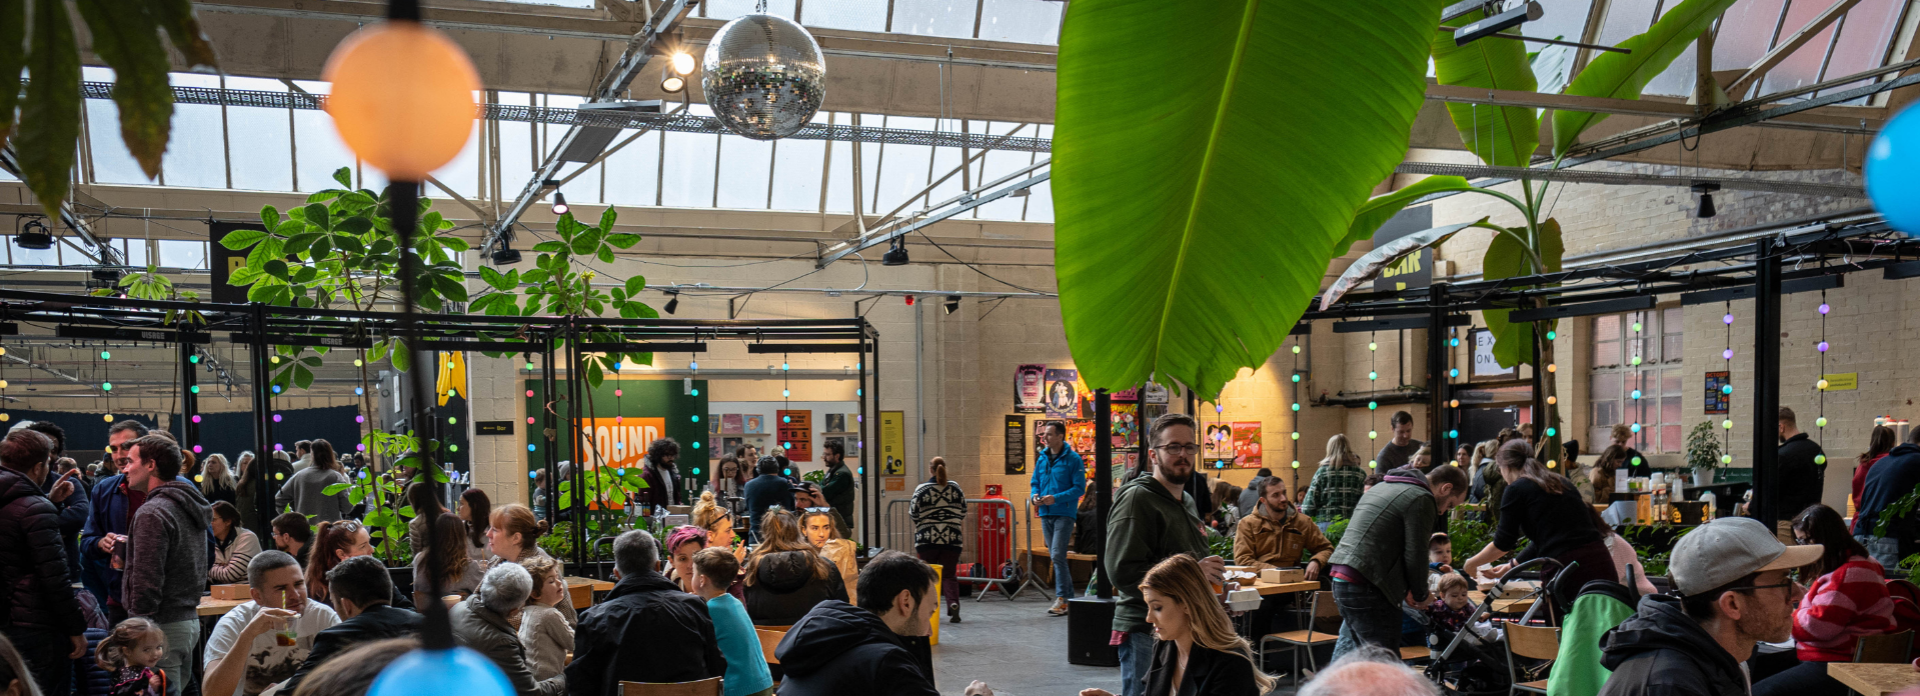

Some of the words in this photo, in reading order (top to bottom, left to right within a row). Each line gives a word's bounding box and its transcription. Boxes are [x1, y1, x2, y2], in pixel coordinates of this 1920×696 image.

[141, 331, 165, 340] VISAGE
[320, 337, 343, 346] VISAGE
[582, 425, 659, 472] SOUND
